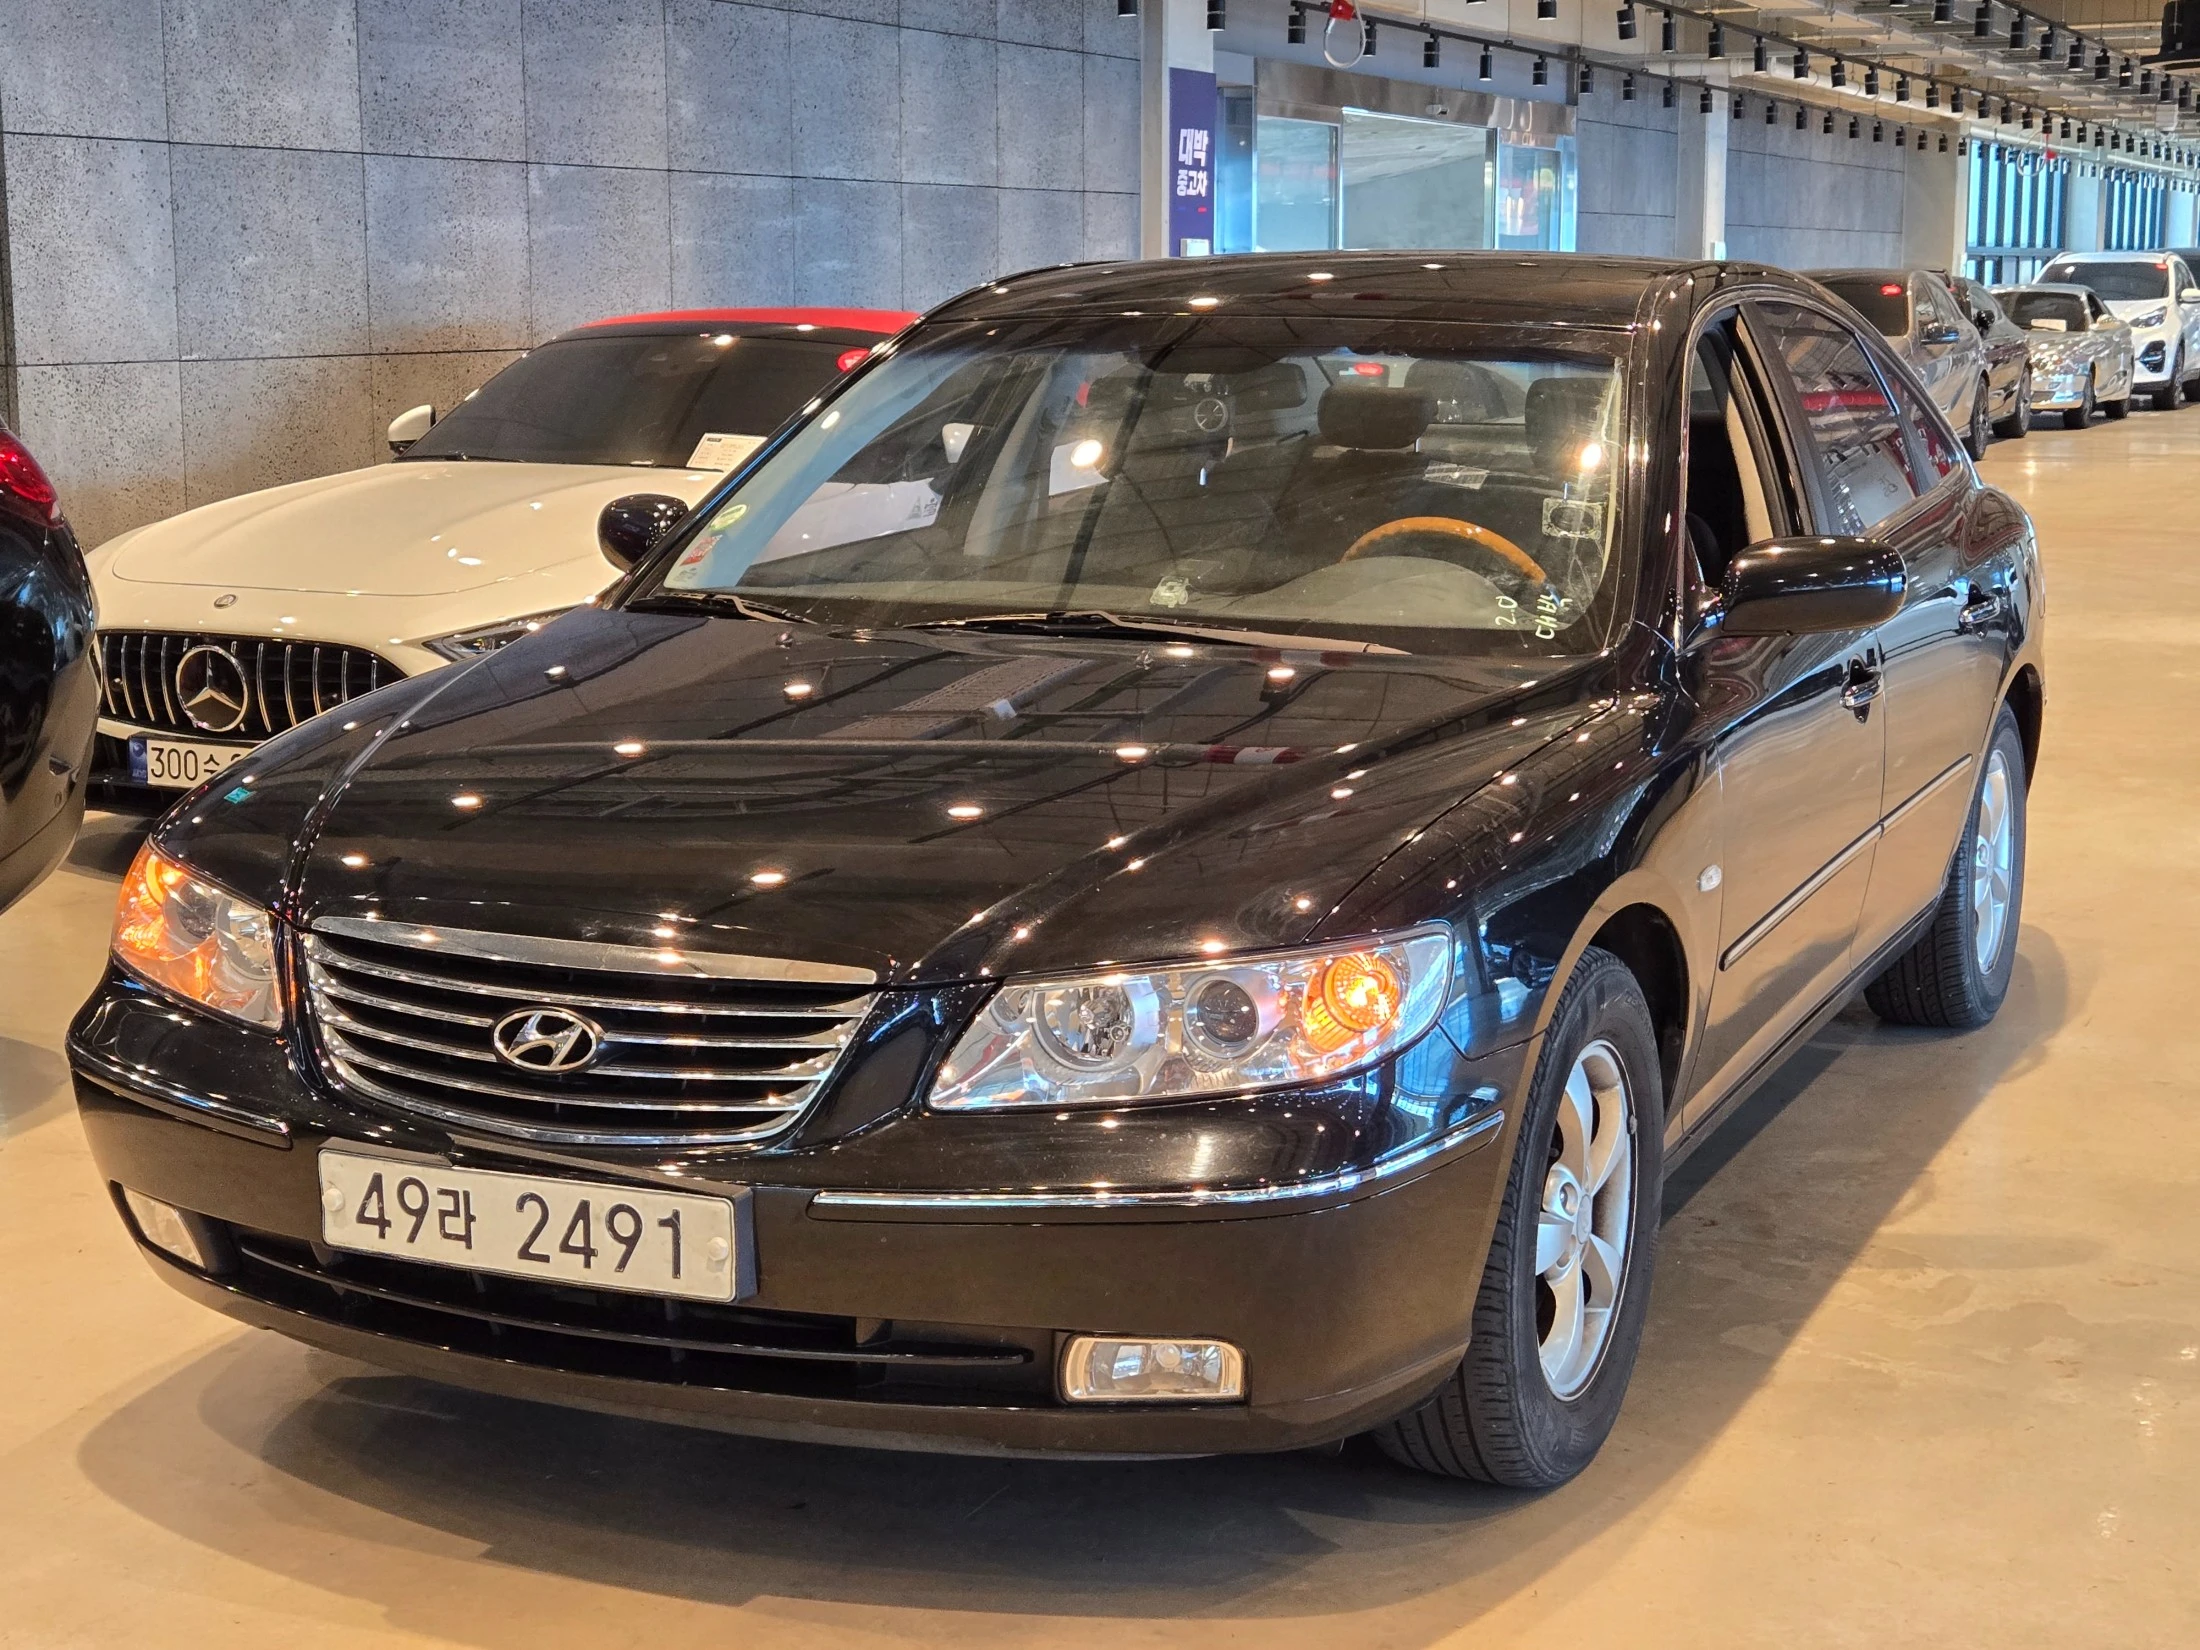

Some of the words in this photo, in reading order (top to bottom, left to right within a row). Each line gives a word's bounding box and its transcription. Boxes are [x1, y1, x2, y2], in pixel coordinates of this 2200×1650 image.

[1178, 128, 1209, 166] 대박
[1177, 169, 1208, 197] 중고차
[1495, 595, 1518, 626] 2.0
[355, 1172, 477, 1250] 49라
[515, 1191, 682, 1279] 2491
